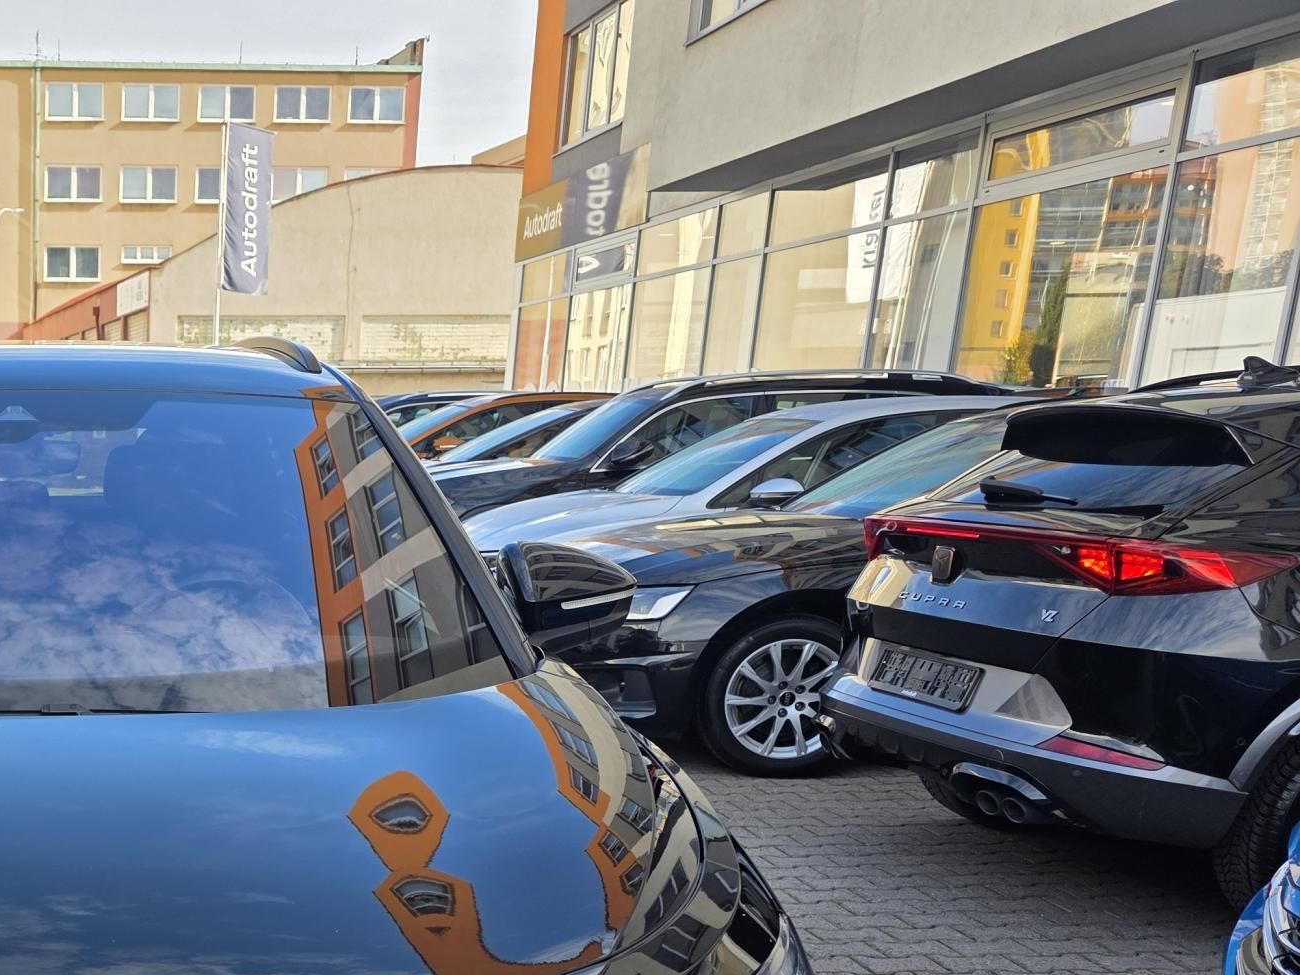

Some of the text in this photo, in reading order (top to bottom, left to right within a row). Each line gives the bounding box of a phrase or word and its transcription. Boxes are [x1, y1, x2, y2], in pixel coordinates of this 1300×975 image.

[240, 143, 259, 277] Autodraft
[523, 201, 563, 241] Autodraft
[899, 590, 967, 610] CUPRA
[1041, 608, 1060, 623] VZ
